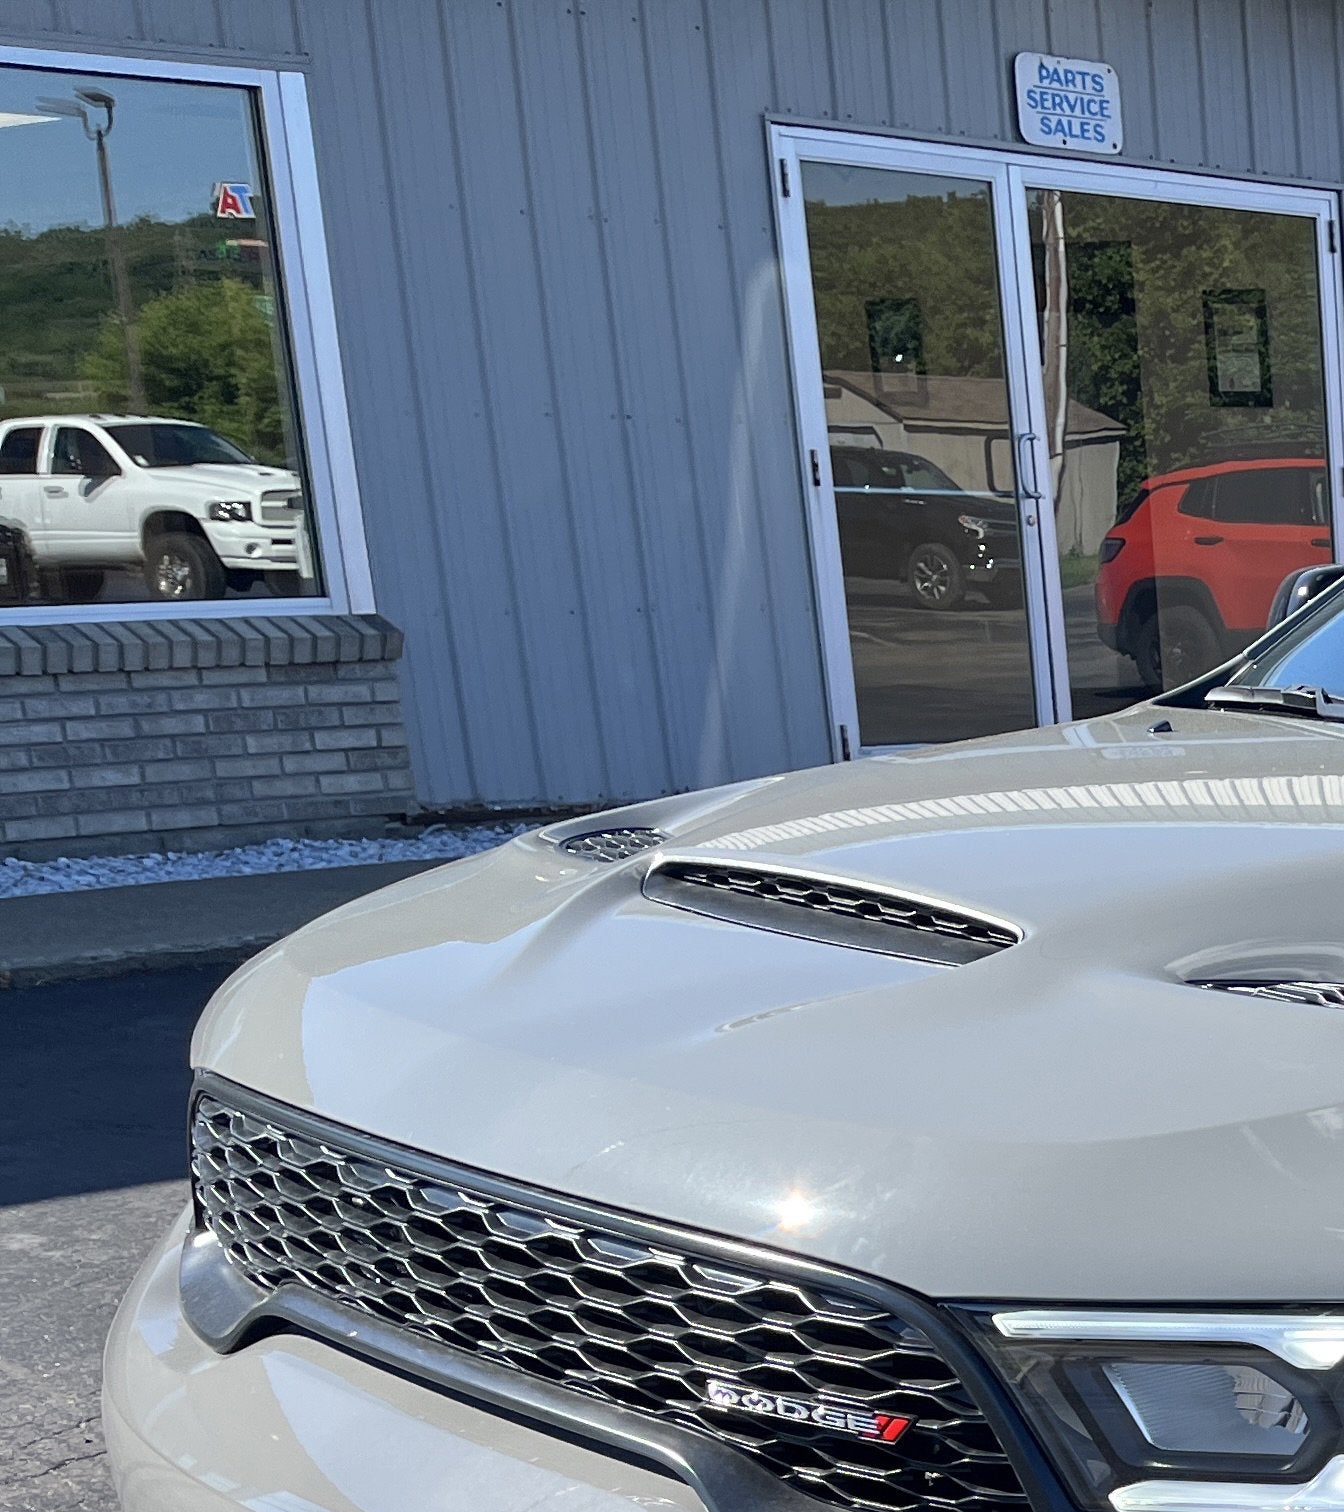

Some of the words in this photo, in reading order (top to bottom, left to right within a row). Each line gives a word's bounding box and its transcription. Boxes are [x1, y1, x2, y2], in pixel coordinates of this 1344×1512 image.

[1037, 63, 1104, 92] PARTS
[1026, 89, 1111, 119] SERVICE
[1040, 116, 1105, 143] SALES
[707, 1380, 881, 1435] DODGE
